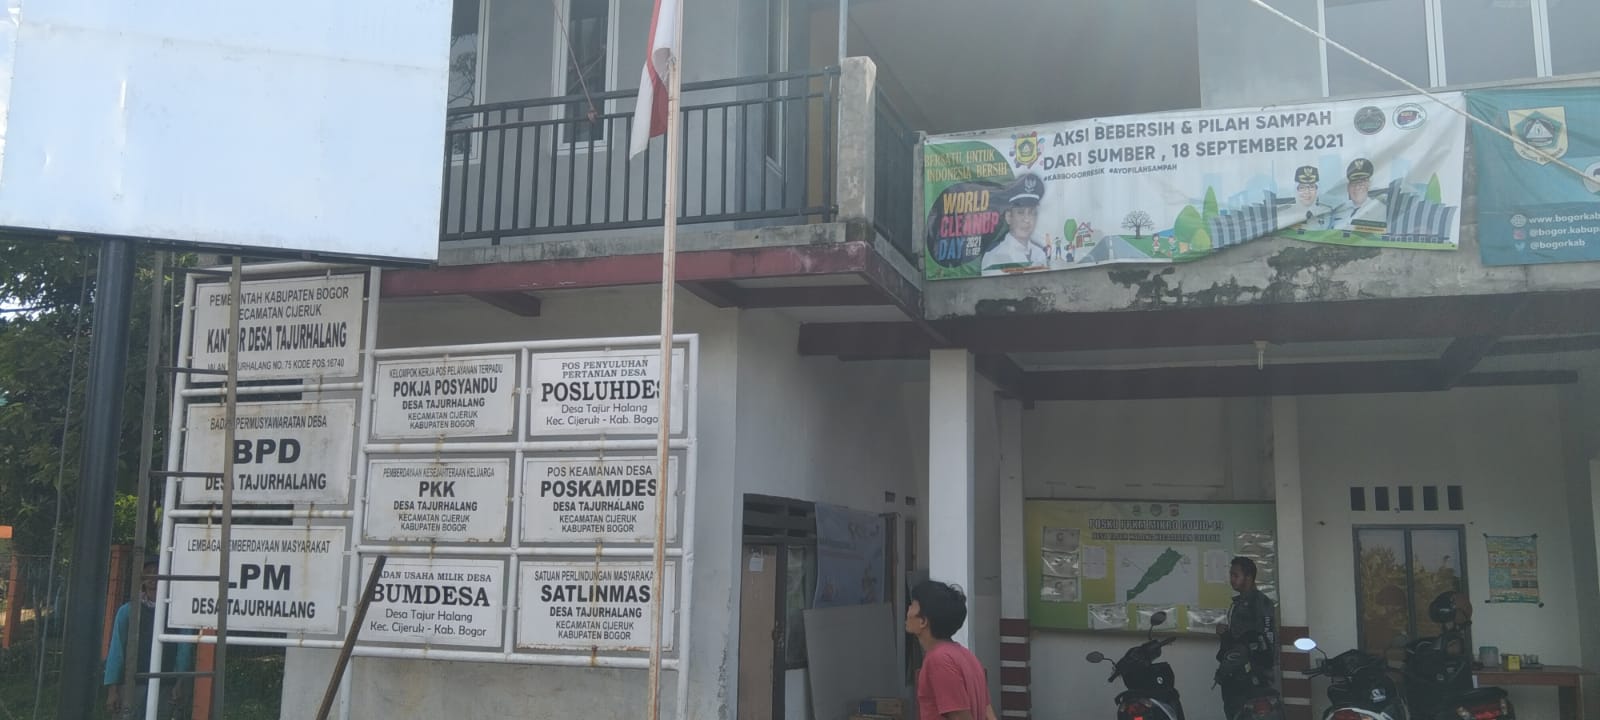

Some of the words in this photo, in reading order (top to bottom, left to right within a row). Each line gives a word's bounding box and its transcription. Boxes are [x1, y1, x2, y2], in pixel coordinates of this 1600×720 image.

[1052, 127, 1089, 148] AKSI
[1094, 121, 1175, 141] BEBERSIH
[1181, 120, 1193, 134] &
[1198, 117, 1249, 133] PILAH
[1255, 110, 1331, 130] SAMPAH
[1043, 151, 1082, 171] DARI
[1087, 145, 1156, 164] SUMBER
[1171, 142, 1190, 158] 18
[1195, 136, 1298, 157] SEPTEMBER
[1303, 133, 1344, 151] 2021
[943, 189, 990, 215] WORLD
[940, 211, 1000, 238] CLEANUP
[1529, 225, 1600, 237] @bogor.kabup
[937, 237, 965, 261] DAY
[1530, 238, 1586, 250] @bogorkab
[209, 292, 262, 306] PEMENTAH
[265, 288, 314, 303] KABUPATEN
[316, 286, 349, 300] BOGOR
[239, 306, 283, 321] ECAMATAN
[285, 303, 322, 318] CIJERUK
[207, 327, 246, 353] KANR
[248, 325, 272, 351] DESA
[276, 322, 347, 351] TAJURHALANG
[293, 359, 310, 369] KODE
[418, 366, 435, 377] KERJA
[479, 363, 503, 374] TERPADU
[561, 362, 580, 370] POS
[583, 359, 649, 369] PENYULUHAN
[562, 369, 617, 379] PERTANIAN
[620, 368, 647, 377] DESA
[393, 380, 431, 397] POKJA
[434, 377, 498, 396] POSYANDU
[402, 400, 423, 410] DESA
[426, 397, 485, 409] TAJURHALANG
[561, 404, 584, 414] Desa
[586, 404, 610, 416] Tajur
[613, 403, 648, 416] Halang
[407, 411, 448, 421] KECAMATAN
[449, 410, 478, 420] CIJERUK
[546, 416, 565, 426] Kec.
[567, 415, 600, 427] Cijeruk
[609, 415, 631, 424] Kab.
[633, 415, 659, 426] Bogo
[235, 415, 306, 430] PERMUSYAWARATAN
[307, 415, 327, 428] DESA
[410, 420, 449, 429] KABUPATEN
[450, 419, 475, 428] BOGOR
[233, 438, 301, 464] BPD
[547, 466, 567, 477] POS
[569, 465, 623, 477] KEAMANAN
[626, 465, 652, 476] DESA
[238, 473, 327, 490] TAJURHALANG
[540, 478, 657, 498] POSKAMDES
[418, 481, 456, 498] PKK
[393, 500, 415, 510] DESA
[417, 500, 478, 511] TAJURHALANG
[553, 501, 576, 512] DESA
[578, 500, 645, 512] TAJURHALANG
[398, 513, 440, 522] KECAMATAN
[441, 514, 470, 522] CIJERUK
[559, 514, 603, 523] KECAMATAN
[605, 514, 637, 523] CIJERUK
[400, 522, 440, 531] KABUPATEN
[441, 523, 467, 531] BOGOR
[561, 524, 605, 533] KABUPATEN
[606, 524, 634, 532] BOGOR
[281, 540, 331, 553] MASYARAKAT
[404, 571, 434, 580] USAHA
[437, 572, 464, 581] MILIK
[467, 573, 492, 583] DESA
[534, 570, 560, 581] SATUAN
[561, 570, 612, 581] PERLINDUNGAN
[614, 570, 654, 581] MASYARAKA
[371, 583, 490, 607] BUMDESA
[540, 584, 651, 603] SATLINMAS
[227, 598, 316, 619] TAJURHALANG
[549, 606, 573, 617] DESA
[576, 606, 642, 618] TAJURHALANG
[385, 608, 408, 619] Desa
[411, 609, 435, 621] Tajur
[437, 610, 473, 623] Halang
[370, 621, 388, 631] Kec.
[391, 622, 425, 634] Cijeruk
[434, 624, 455, 635] Kab.
[458, 625, 487, 637] Bogor
[555, 620, 600, 630] KECAMATAN
[602, 621, 634, 630] CIJERUK
[558, 630, 602, 639] KABUPATEN
[603, 631, 631, 640] BOGOR
